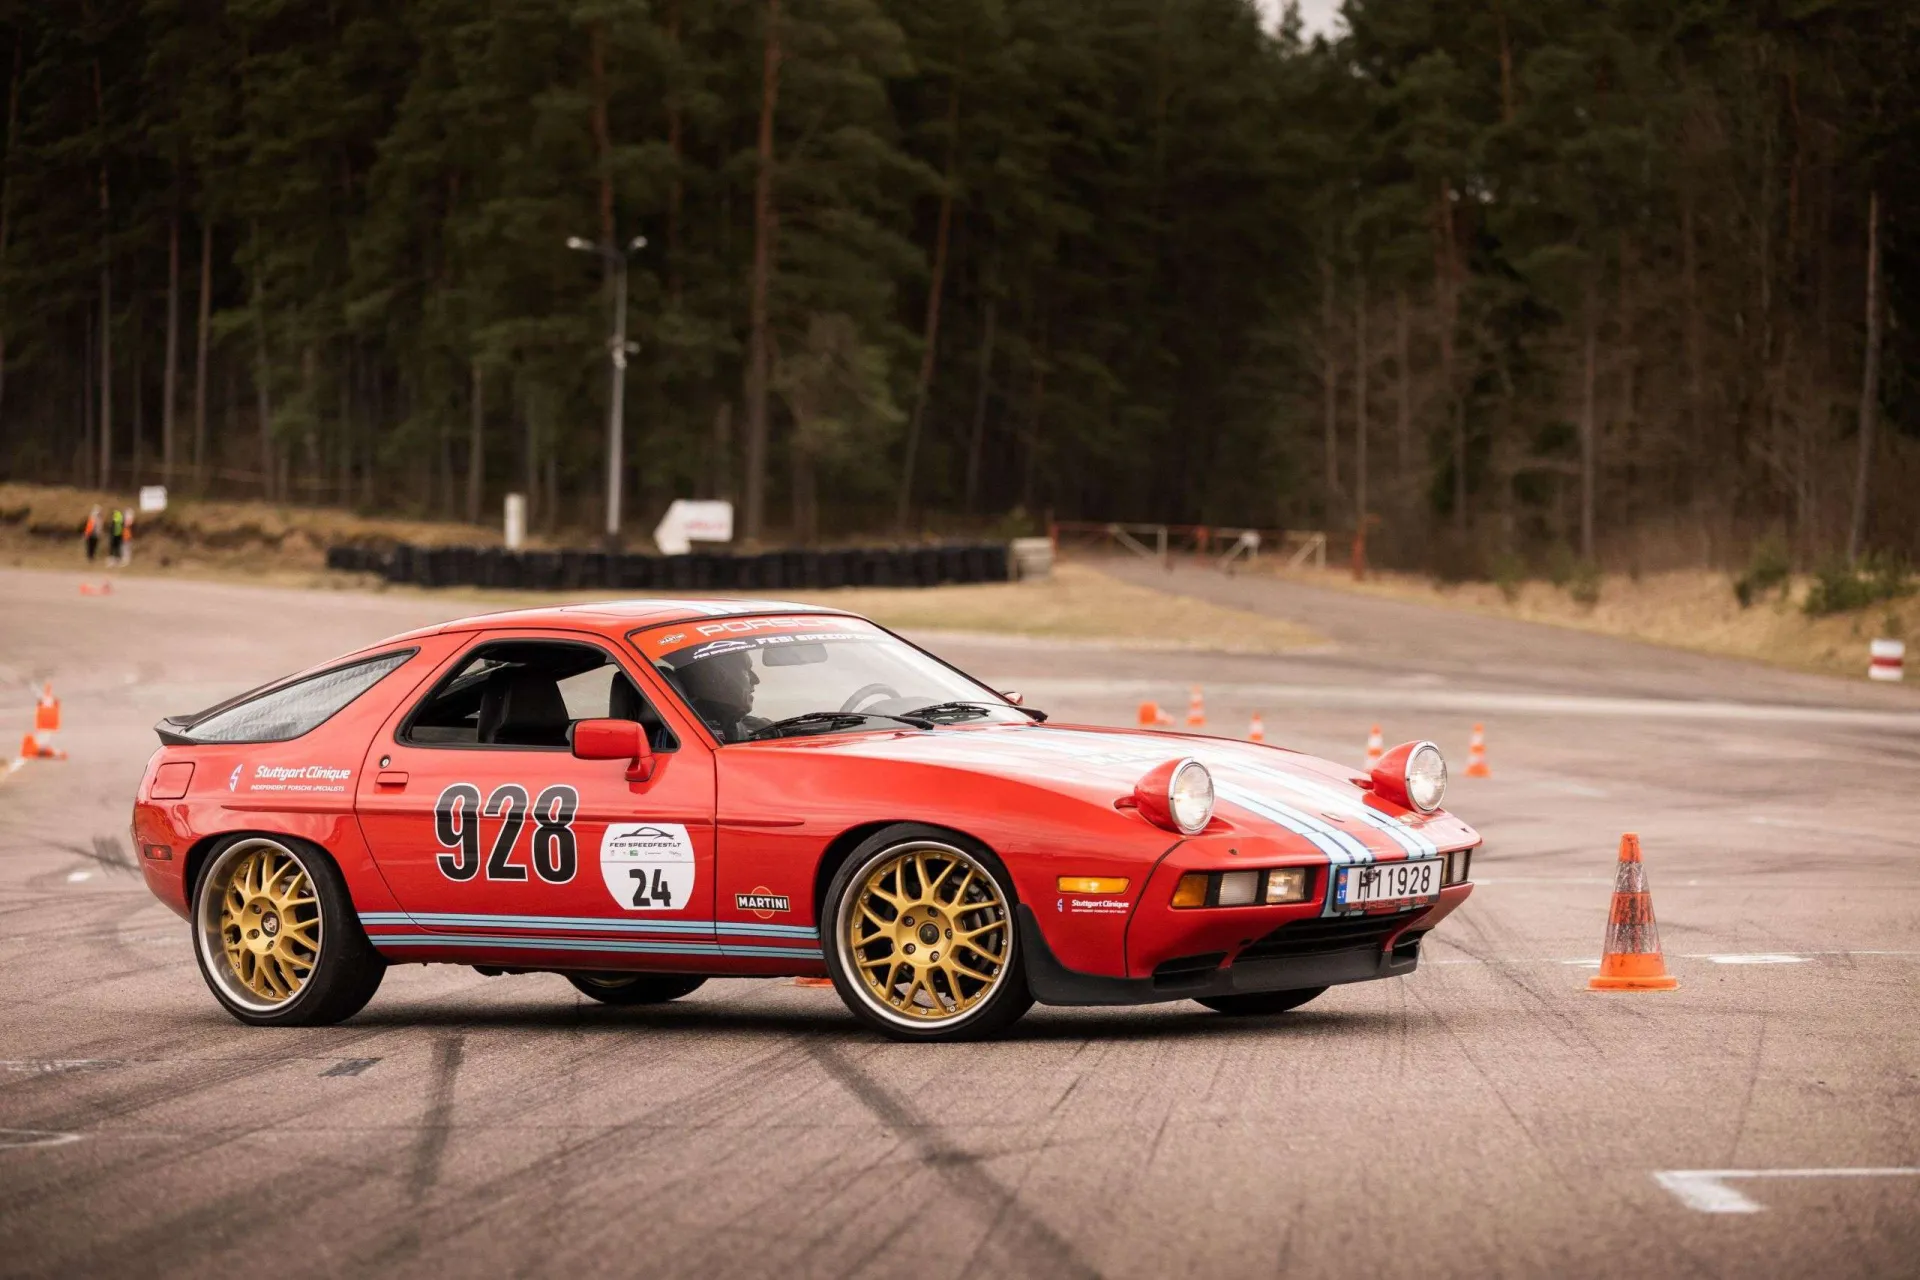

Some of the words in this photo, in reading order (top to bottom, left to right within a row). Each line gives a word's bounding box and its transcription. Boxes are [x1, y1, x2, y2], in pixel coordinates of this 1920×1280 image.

[696, 617, 834, 636] PORSC
[255, 765, 306, 781] Stuttgart
[306, 766, 351, 781] Clinique
[434, 782, 579, 885] 928
[629, 868, 671, 908] 24
[1337, 890, 1346, 899] LT
[738, 896, 788, 909] MARTINI
[1071, 899, 1102, 908] Stuttgart
[1102, 900, 1129, 908] Clinique
